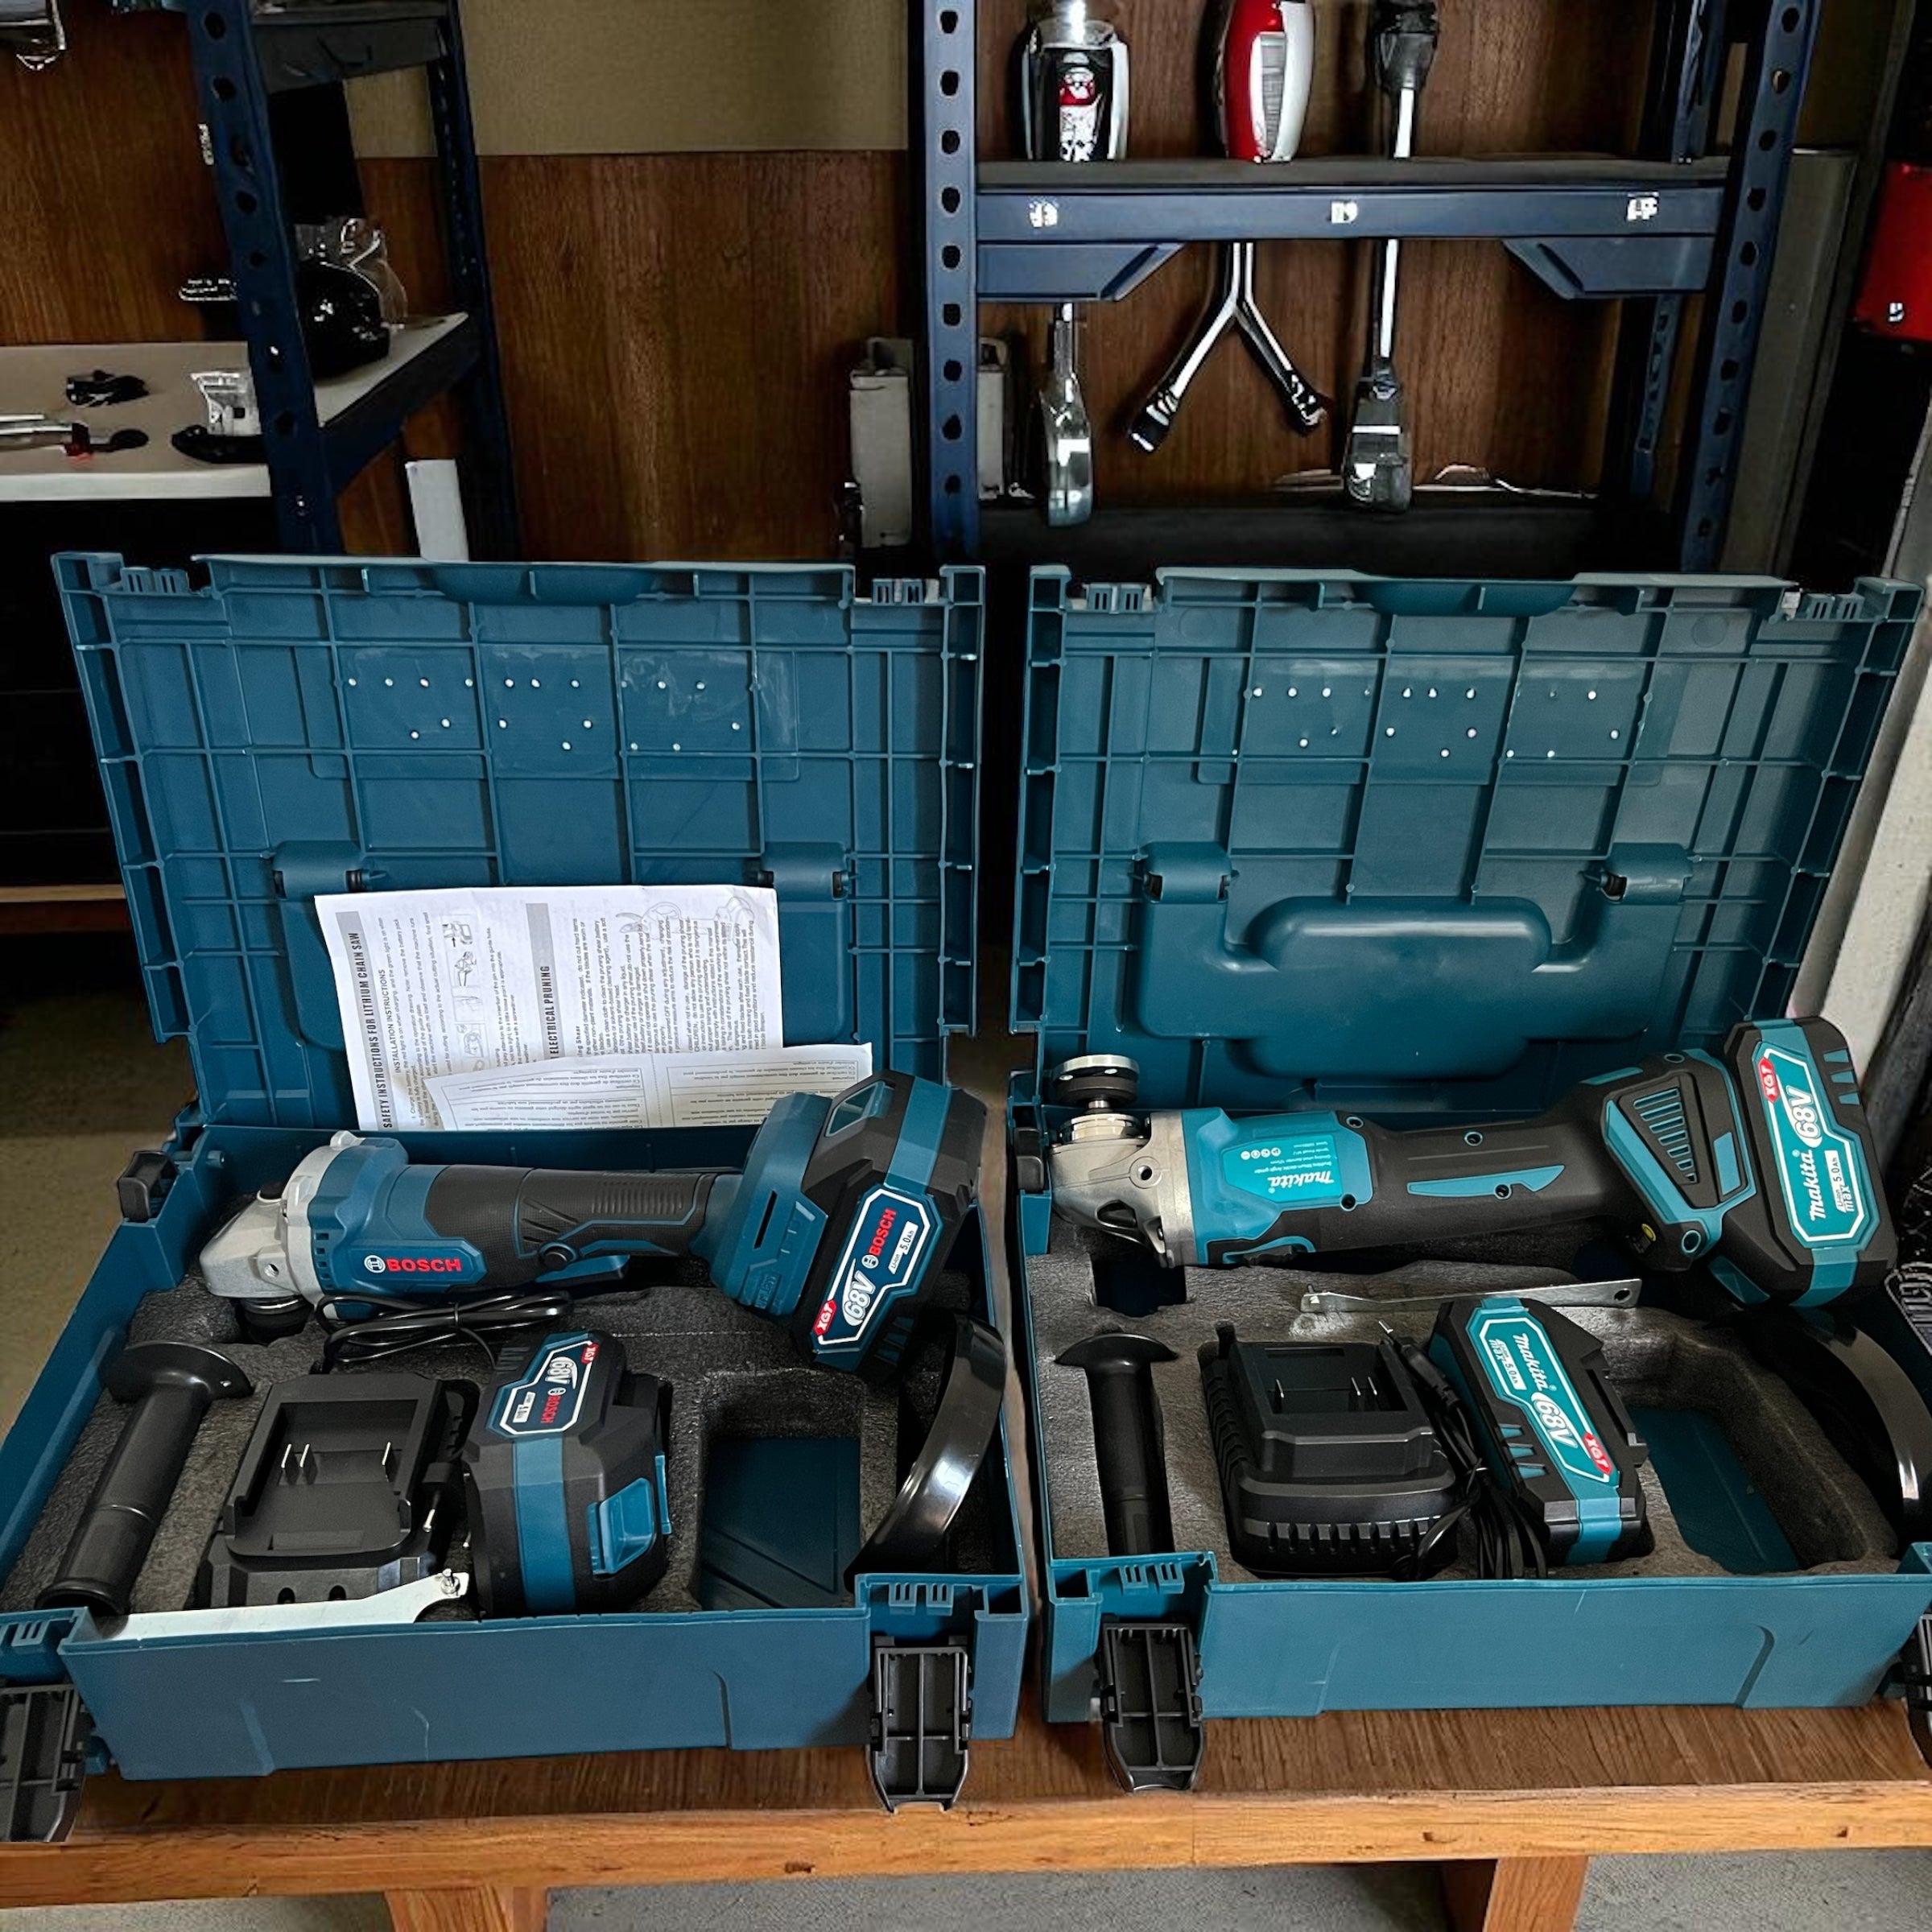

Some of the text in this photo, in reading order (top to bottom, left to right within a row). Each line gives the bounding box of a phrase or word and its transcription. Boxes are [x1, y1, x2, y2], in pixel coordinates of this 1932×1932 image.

[597, 955, 605, 974] pruning
[539, 966, 559, 1053] ELECTRICAL PRUNING
[628, 987, 636, 1005] pruning
[348, 932, 393, 1127] SAFETY INSTRUCTIONS FOR LITHIUM CHAIN SAW
[378, 968, 401, 1072] INSTALLATION INSTRUCTIONS
[617, 1014, 625, 1034] pruning
[1760, 1066, 1777, 1097] XGT
[1785, 1085, 1820, 1140] 68V
[1833, 1156, 1844, 1183] 5.0Ah
[869, 1208, 897, 1256] BOSCH
[900, 1230, 914, 1251] 5.0Ah
[386, 1257, 462, 1272] BOSCH
[842, 1270, 876, 1320] 68V
[816, 1303, 836, 1331] XGT
[544, 1360, 574, 1385] 68V
[541, 1395, 562, 1423] BOSCH
[1533, 1399, 1578, 1449] 68V
[1586, 1438, 1609, 1470] XGT
